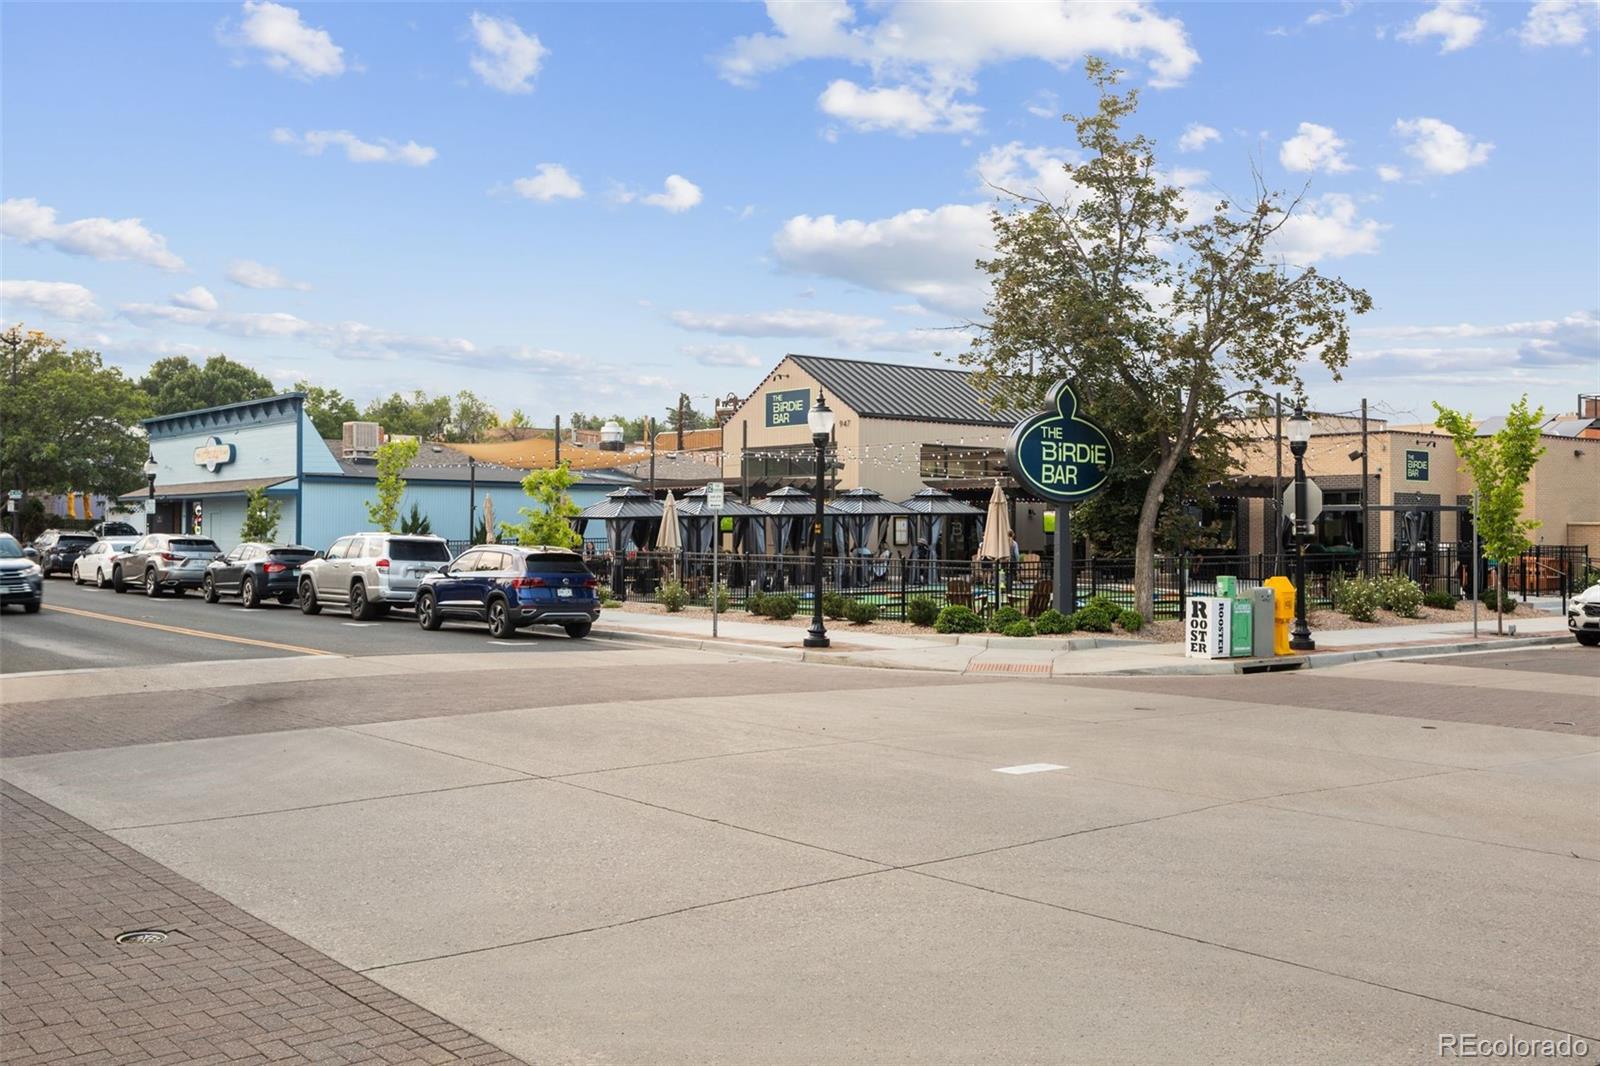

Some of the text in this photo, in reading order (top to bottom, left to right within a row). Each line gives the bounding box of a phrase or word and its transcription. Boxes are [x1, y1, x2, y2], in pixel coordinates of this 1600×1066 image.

[773, 413, 790, 424] BAR
[1041, 426, 1063, 439] THE
[1041, 464, 1078, 485] BAR
